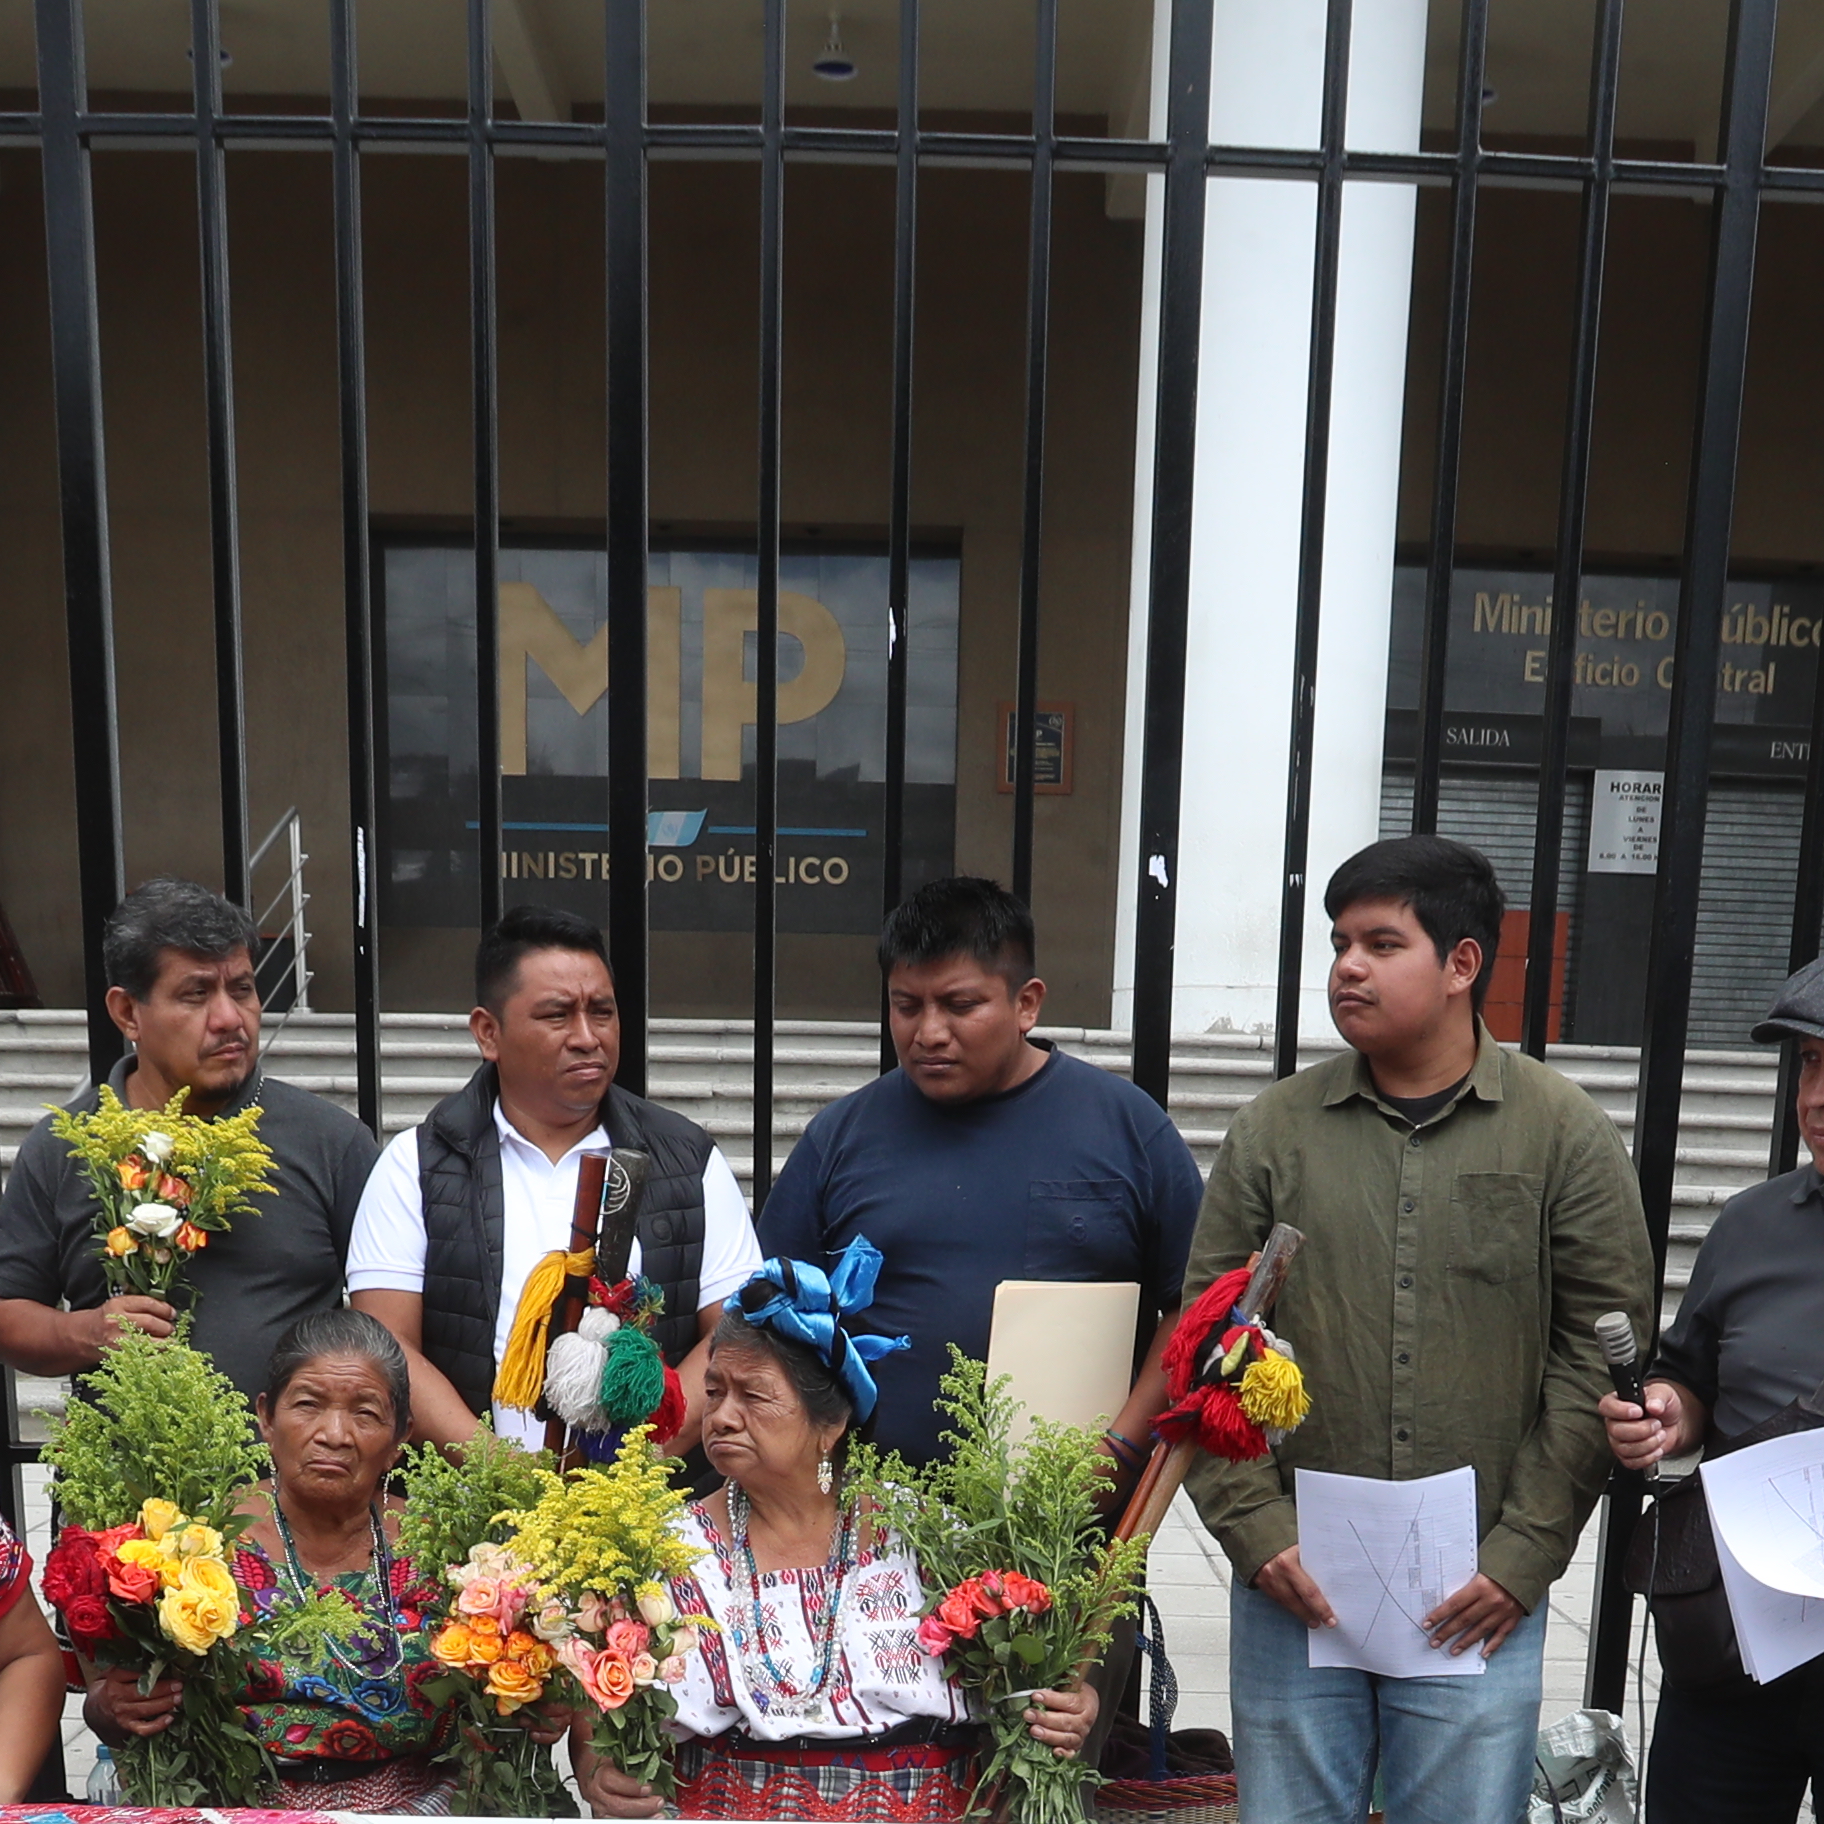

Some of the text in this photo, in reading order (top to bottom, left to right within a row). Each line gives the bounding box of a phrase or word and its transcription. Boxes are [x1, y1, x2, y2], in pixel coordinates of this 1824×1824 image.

[1473, 593, 1823, 647] Miniterio úblic
[497, 582, 846, 782] MP
[1523, 650, 1776, 694] Eficio Ctral
[1446, 726, 1511, 747] SALIDA
[1610, 781, 1662, 794] HORAR
[1628, 815, 1655, 823] LUNES
